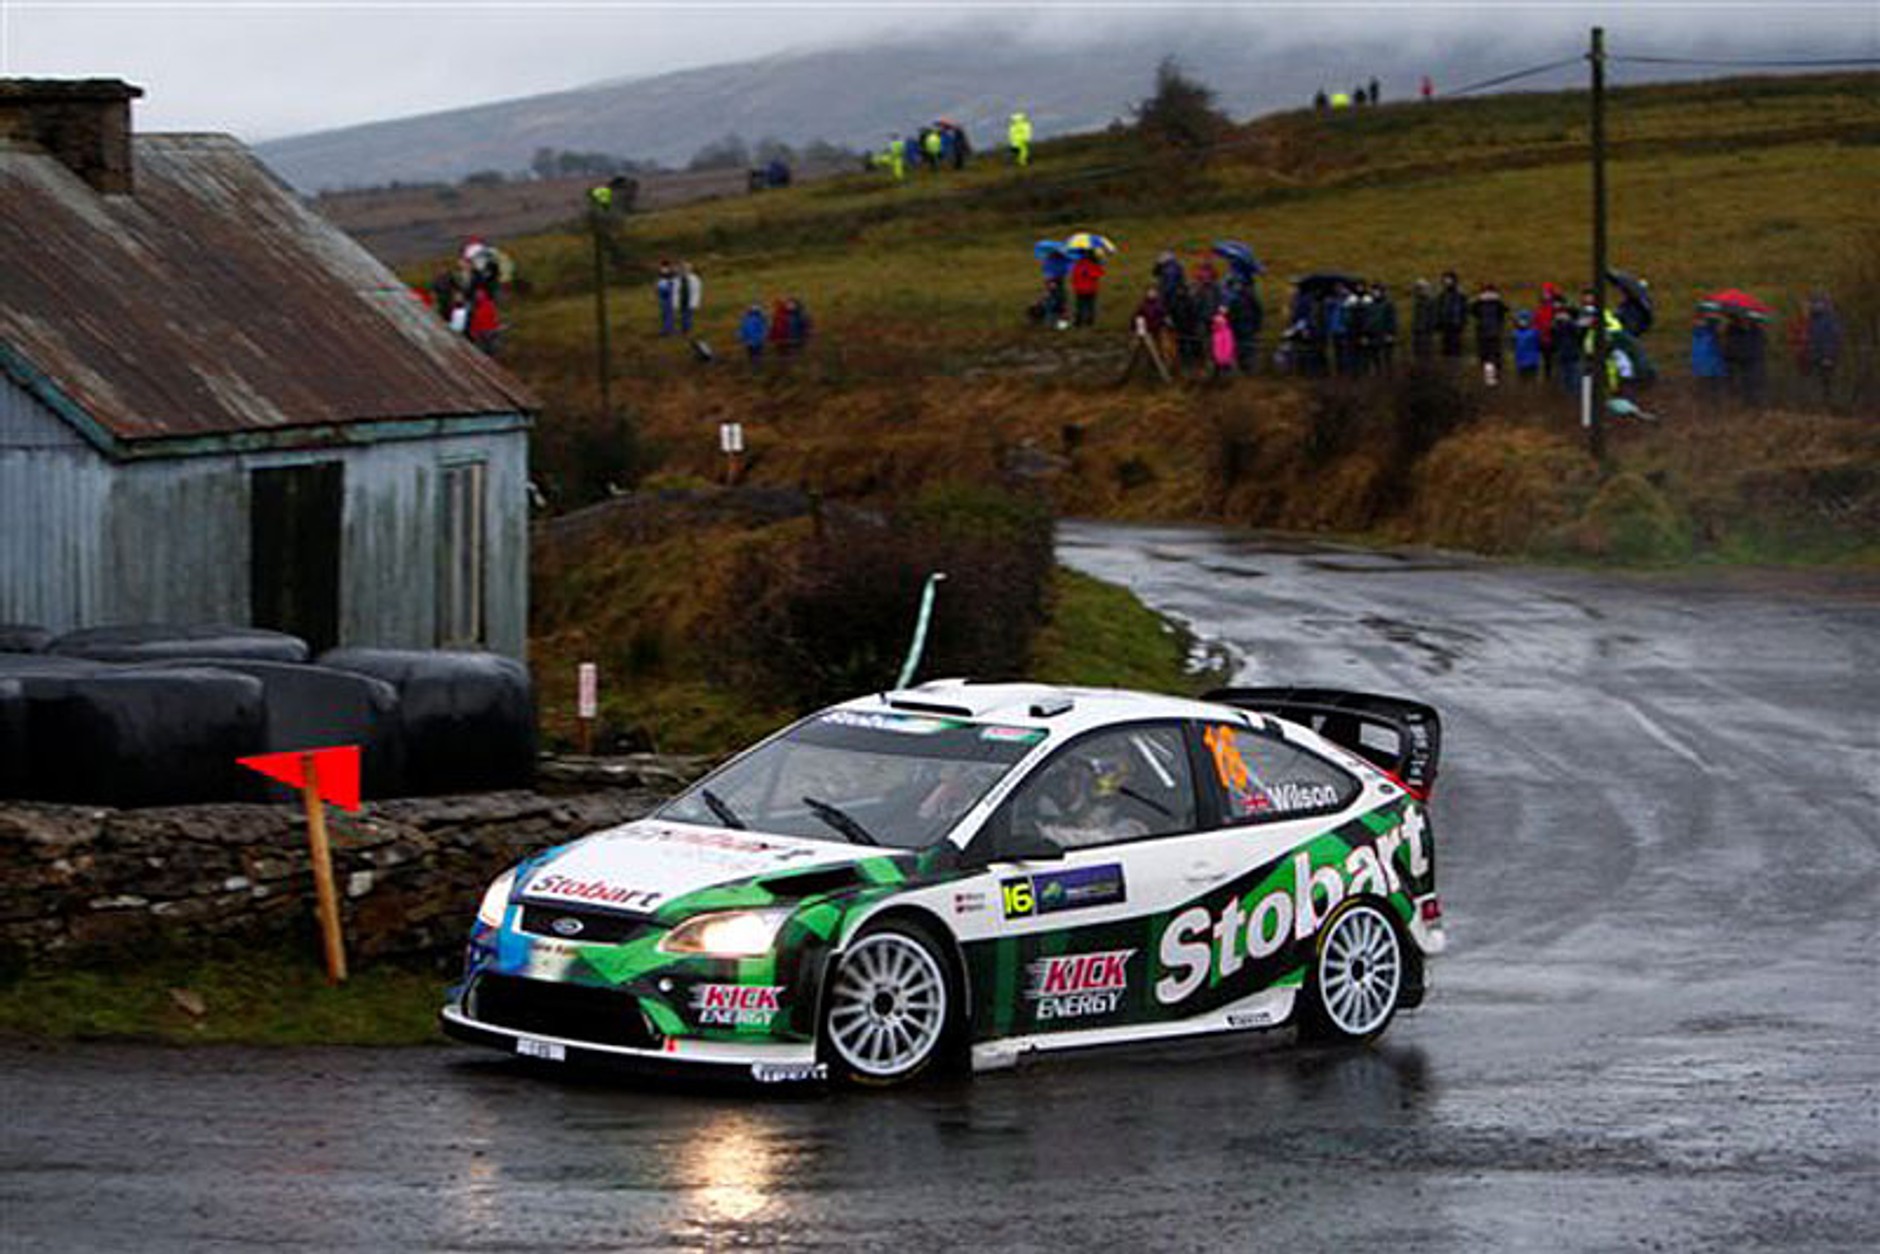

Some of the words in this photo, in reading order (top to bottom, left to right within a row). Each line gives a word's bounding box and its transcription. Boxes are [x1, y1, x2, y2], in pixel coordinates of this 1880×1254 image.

[1266, 783, 1339, 812] Wilson
[531, 874, 663, 908] Stobart
[1002, 883, 1036, 915] 16
[1155, 803, 1429, 1004] Stobart
[1041, 951, 1132, 994] KICK
[704, 985, 782, 1010] KICK
[1036, 991, 1121, 1020] ENERGY
